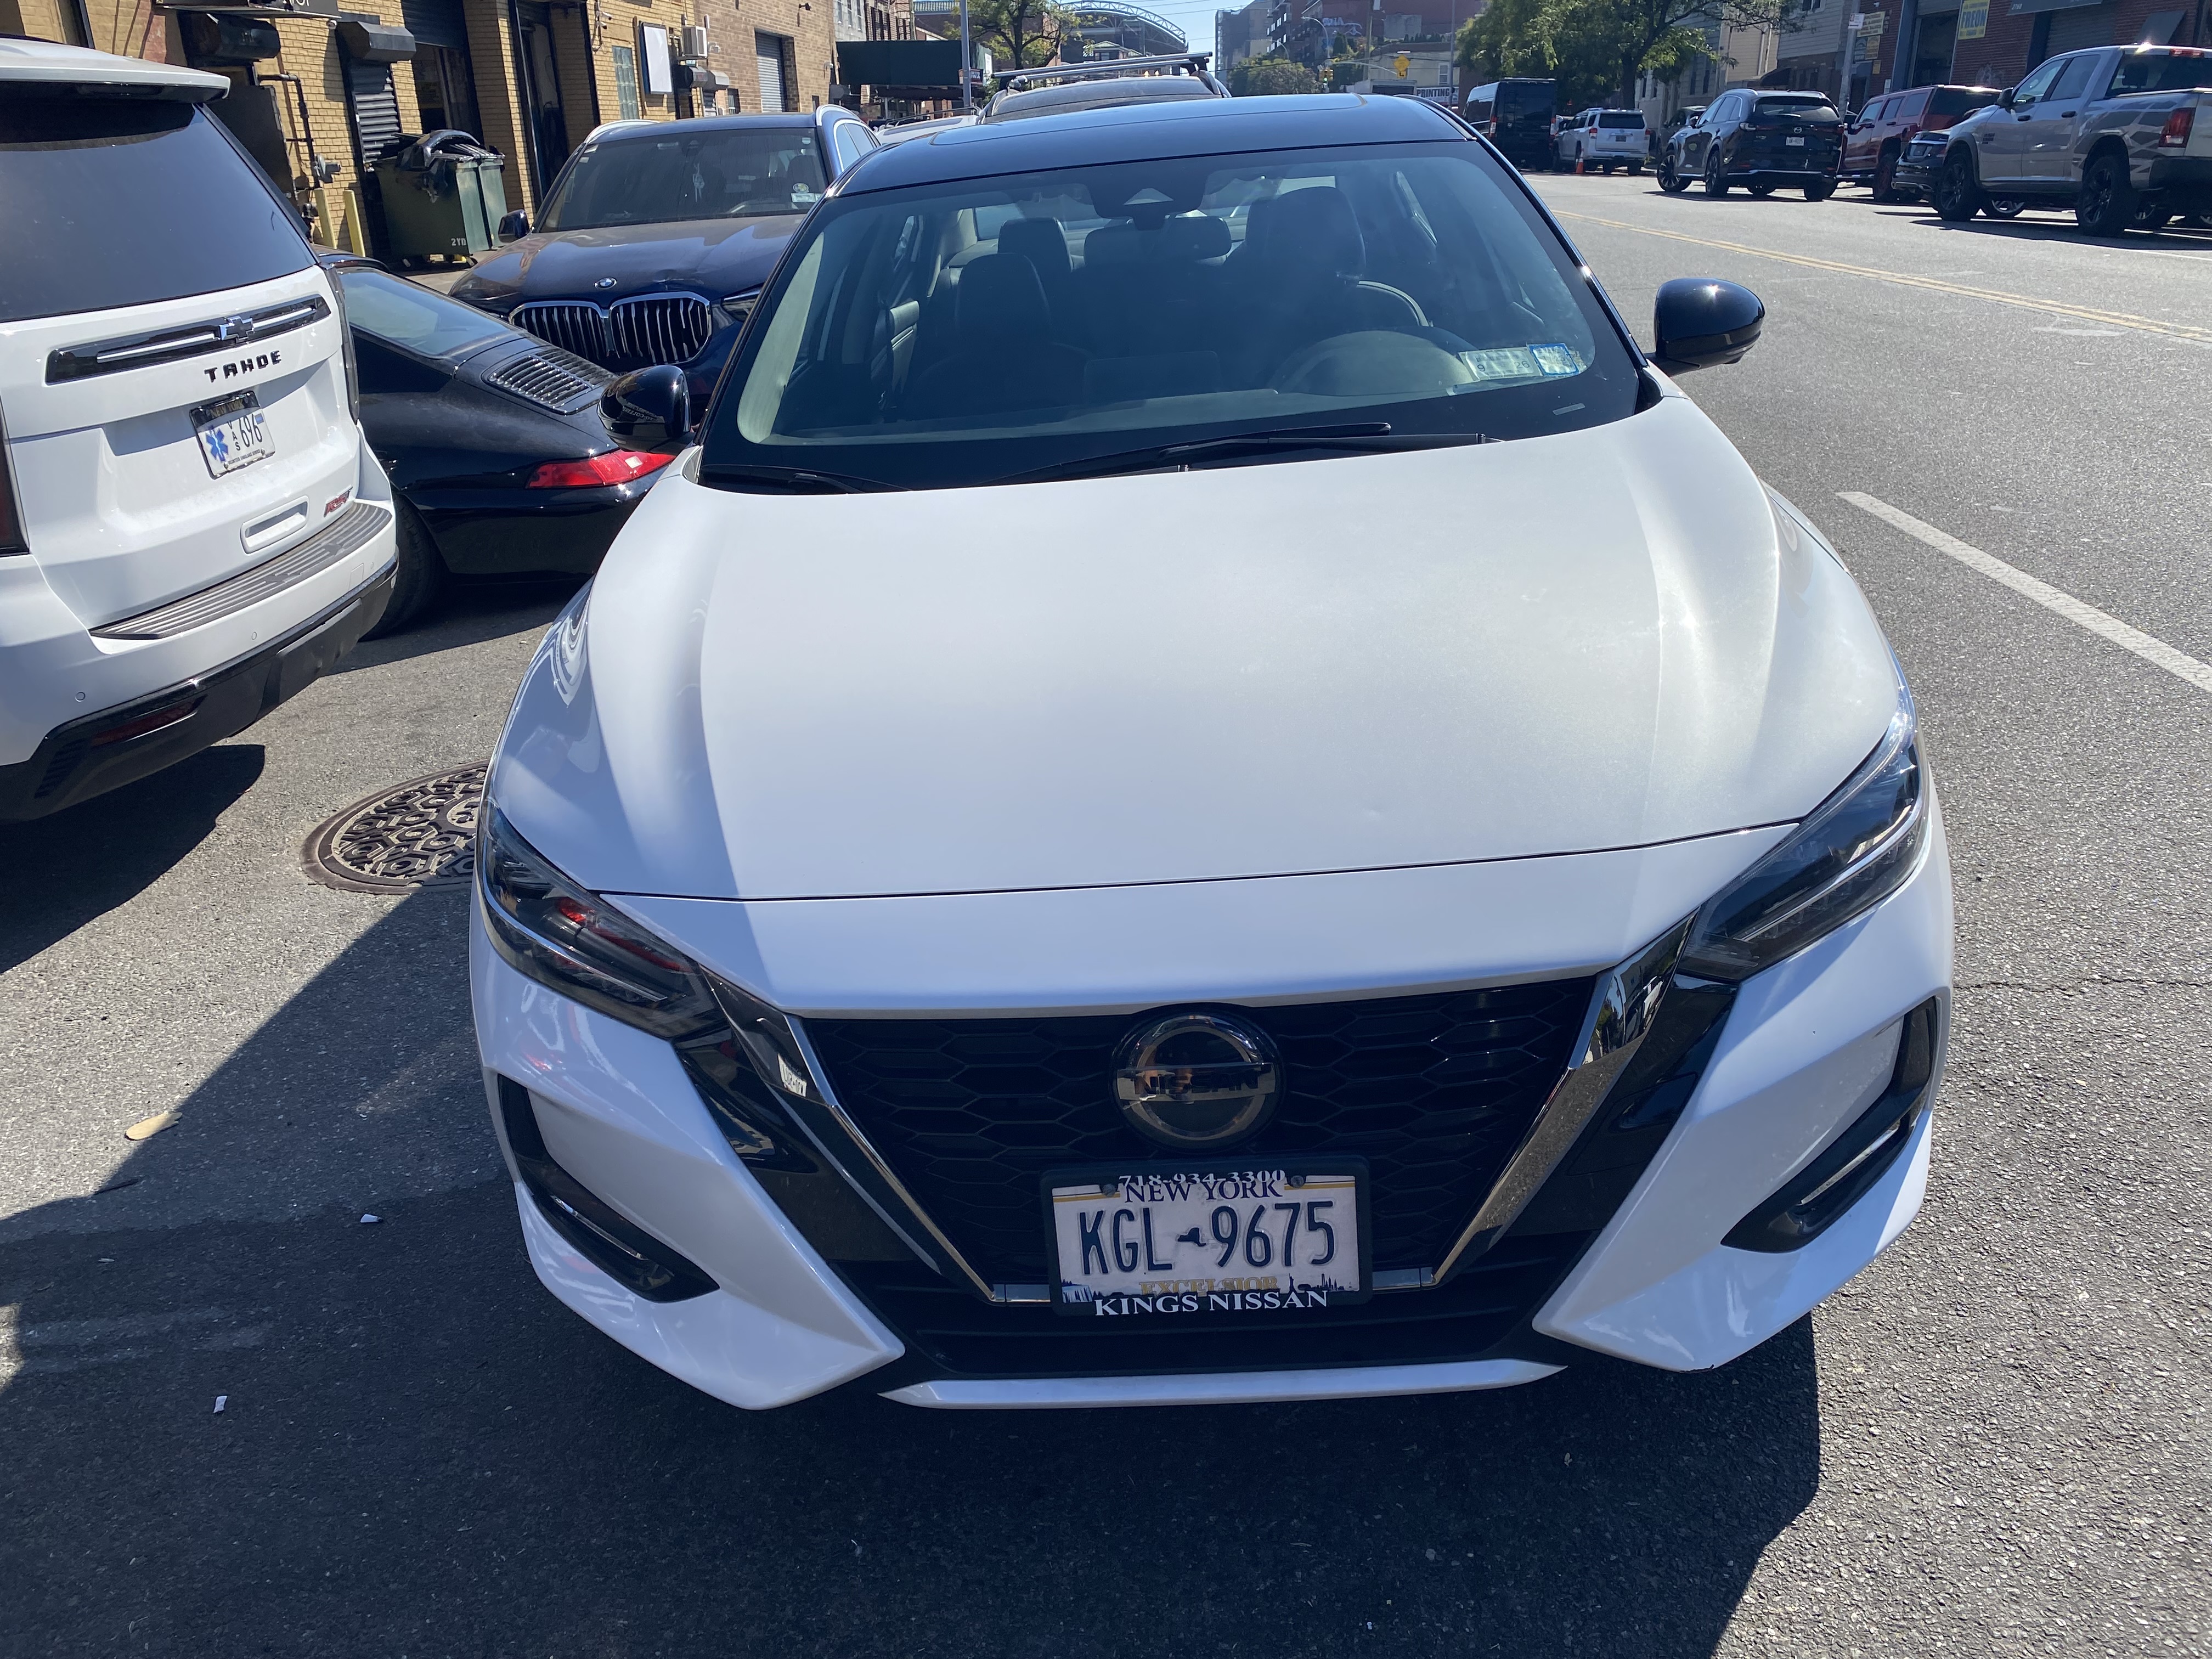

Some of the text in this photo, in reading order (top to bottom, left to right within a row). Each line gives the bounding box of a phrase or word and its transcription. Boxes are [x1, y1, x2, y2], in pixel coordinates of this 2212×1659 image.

[1961, 9, 1987, 29] FREON
[1417, 88, 1449, 98] PRINTING
[451, 238, 466, 246] 2YD
[204, 350, 281, 382] TAHOE
[1515, 360, 1530, 369] 26
[210, 399, 245, 419] NEW YORK
[239, 413, 263, 447] 696
[324, 490, 350, 517] RST
[1119, 1170, 1285, 1187] 718-934-3300
[1124, 1179, 1283, 1203] NEW YORK
[1079, 1201, 1333, 1275] KGL 9675
[1139, 1276, 1280, 1296] EXCELSIOR
[1093, 1290, 1328, 1316] KINGS NISSAN
